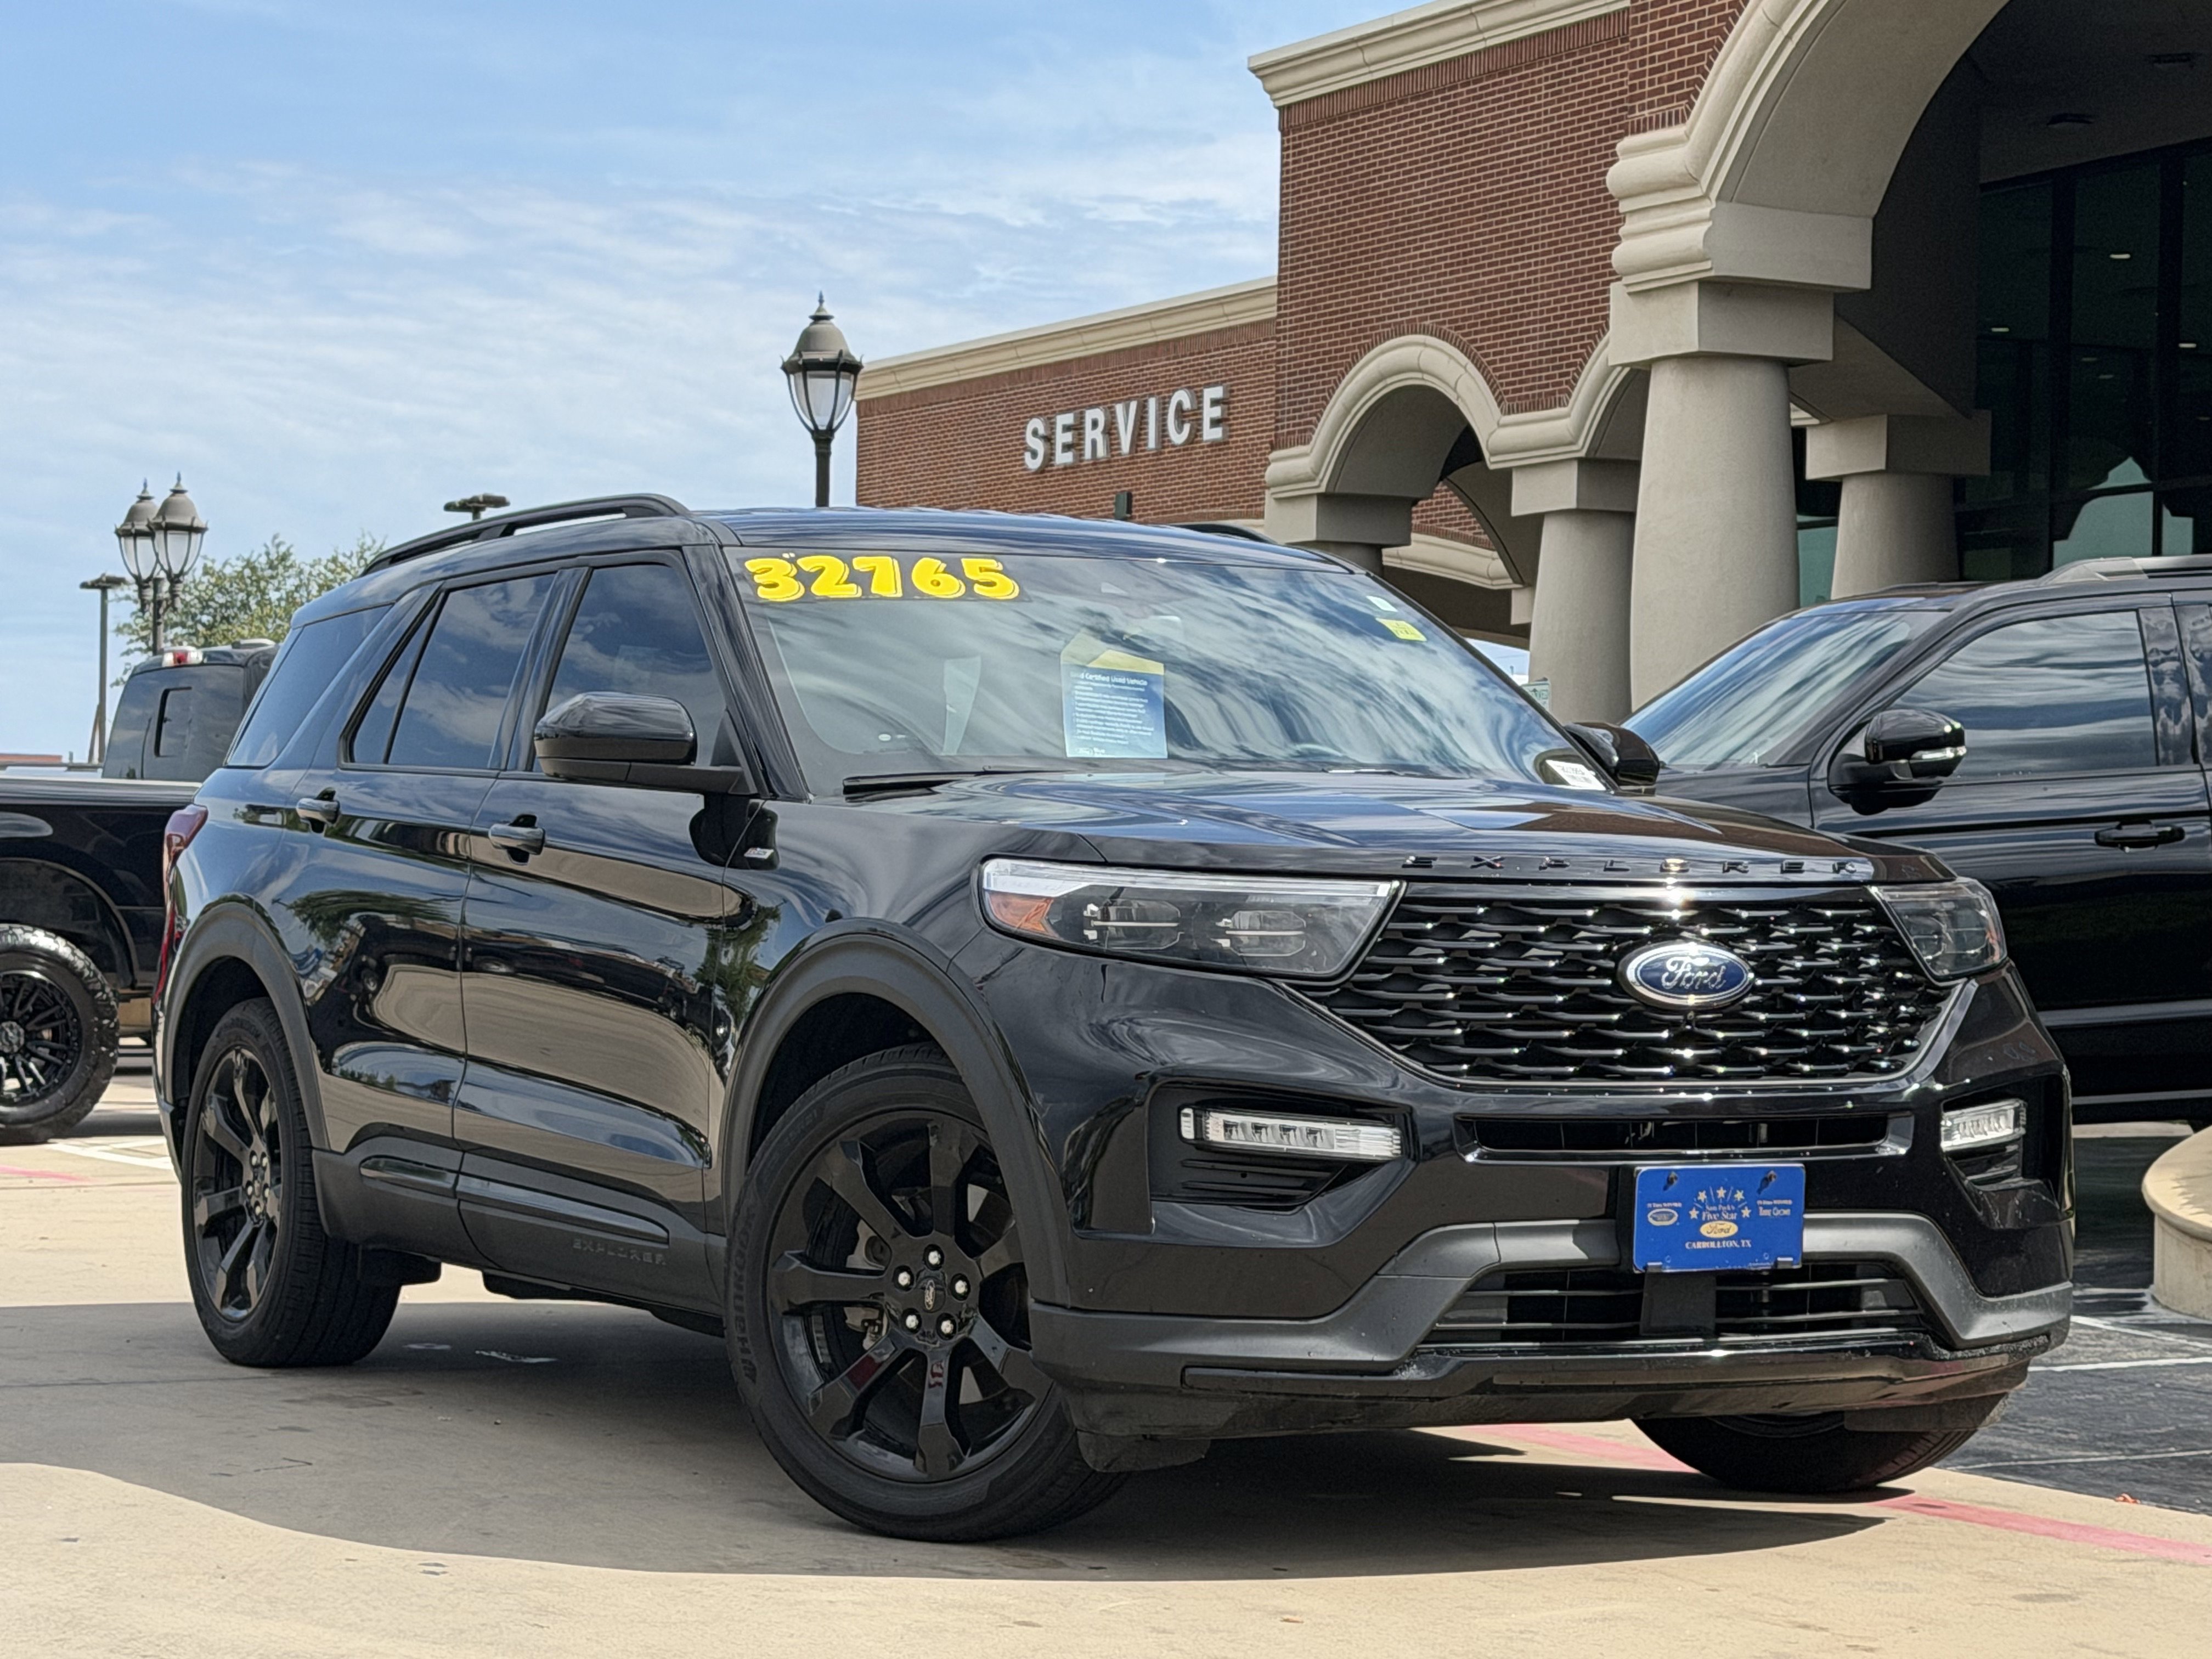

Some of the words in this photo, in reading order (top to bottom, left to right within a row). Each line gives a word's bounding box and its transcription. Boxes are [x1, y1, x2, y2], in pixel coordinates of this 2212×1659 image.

[1024, 385, 1228, 471] SERVICE
[744, 555, 1019, 602] 32765
[1402, 855, 1857, 874] EXPLORER
[1702, 1211, 1719, 1221] Five
[1722, 1211, 1737, 1220] Star
[1741, 1239, 1752, 1248] TX
